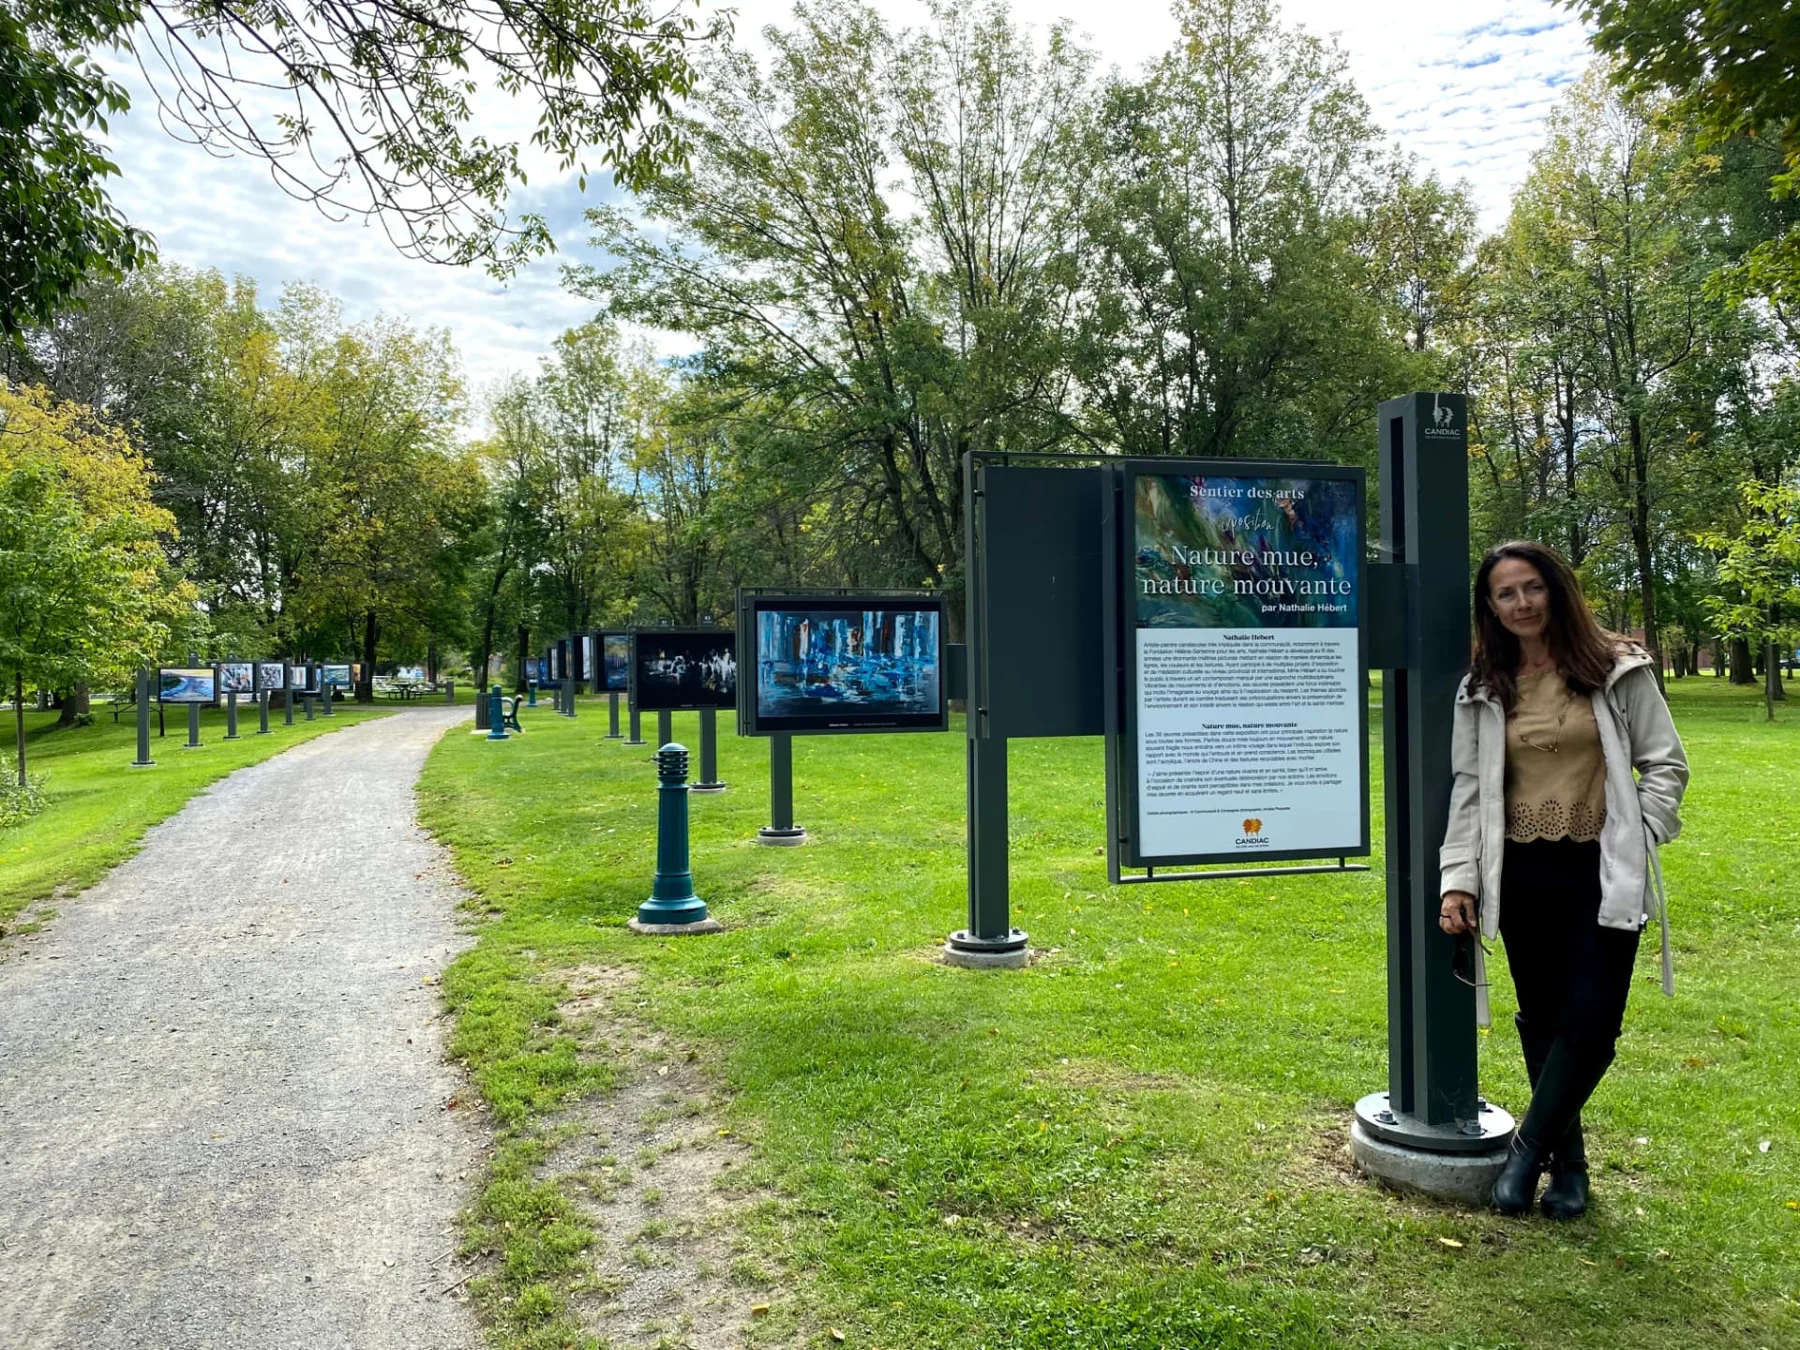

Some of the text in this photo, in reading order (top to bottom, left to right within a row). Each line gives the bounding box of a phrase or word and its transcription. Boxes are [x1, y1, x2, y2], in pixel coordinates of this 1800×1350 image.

[1190, 485, 1304, 499] Sentier des arts
[1172, 546, 1318, 569] Nature mue,
[1143, 576, 1351, 594] nature mouvante
[1262, 605, 1277, 613] par
